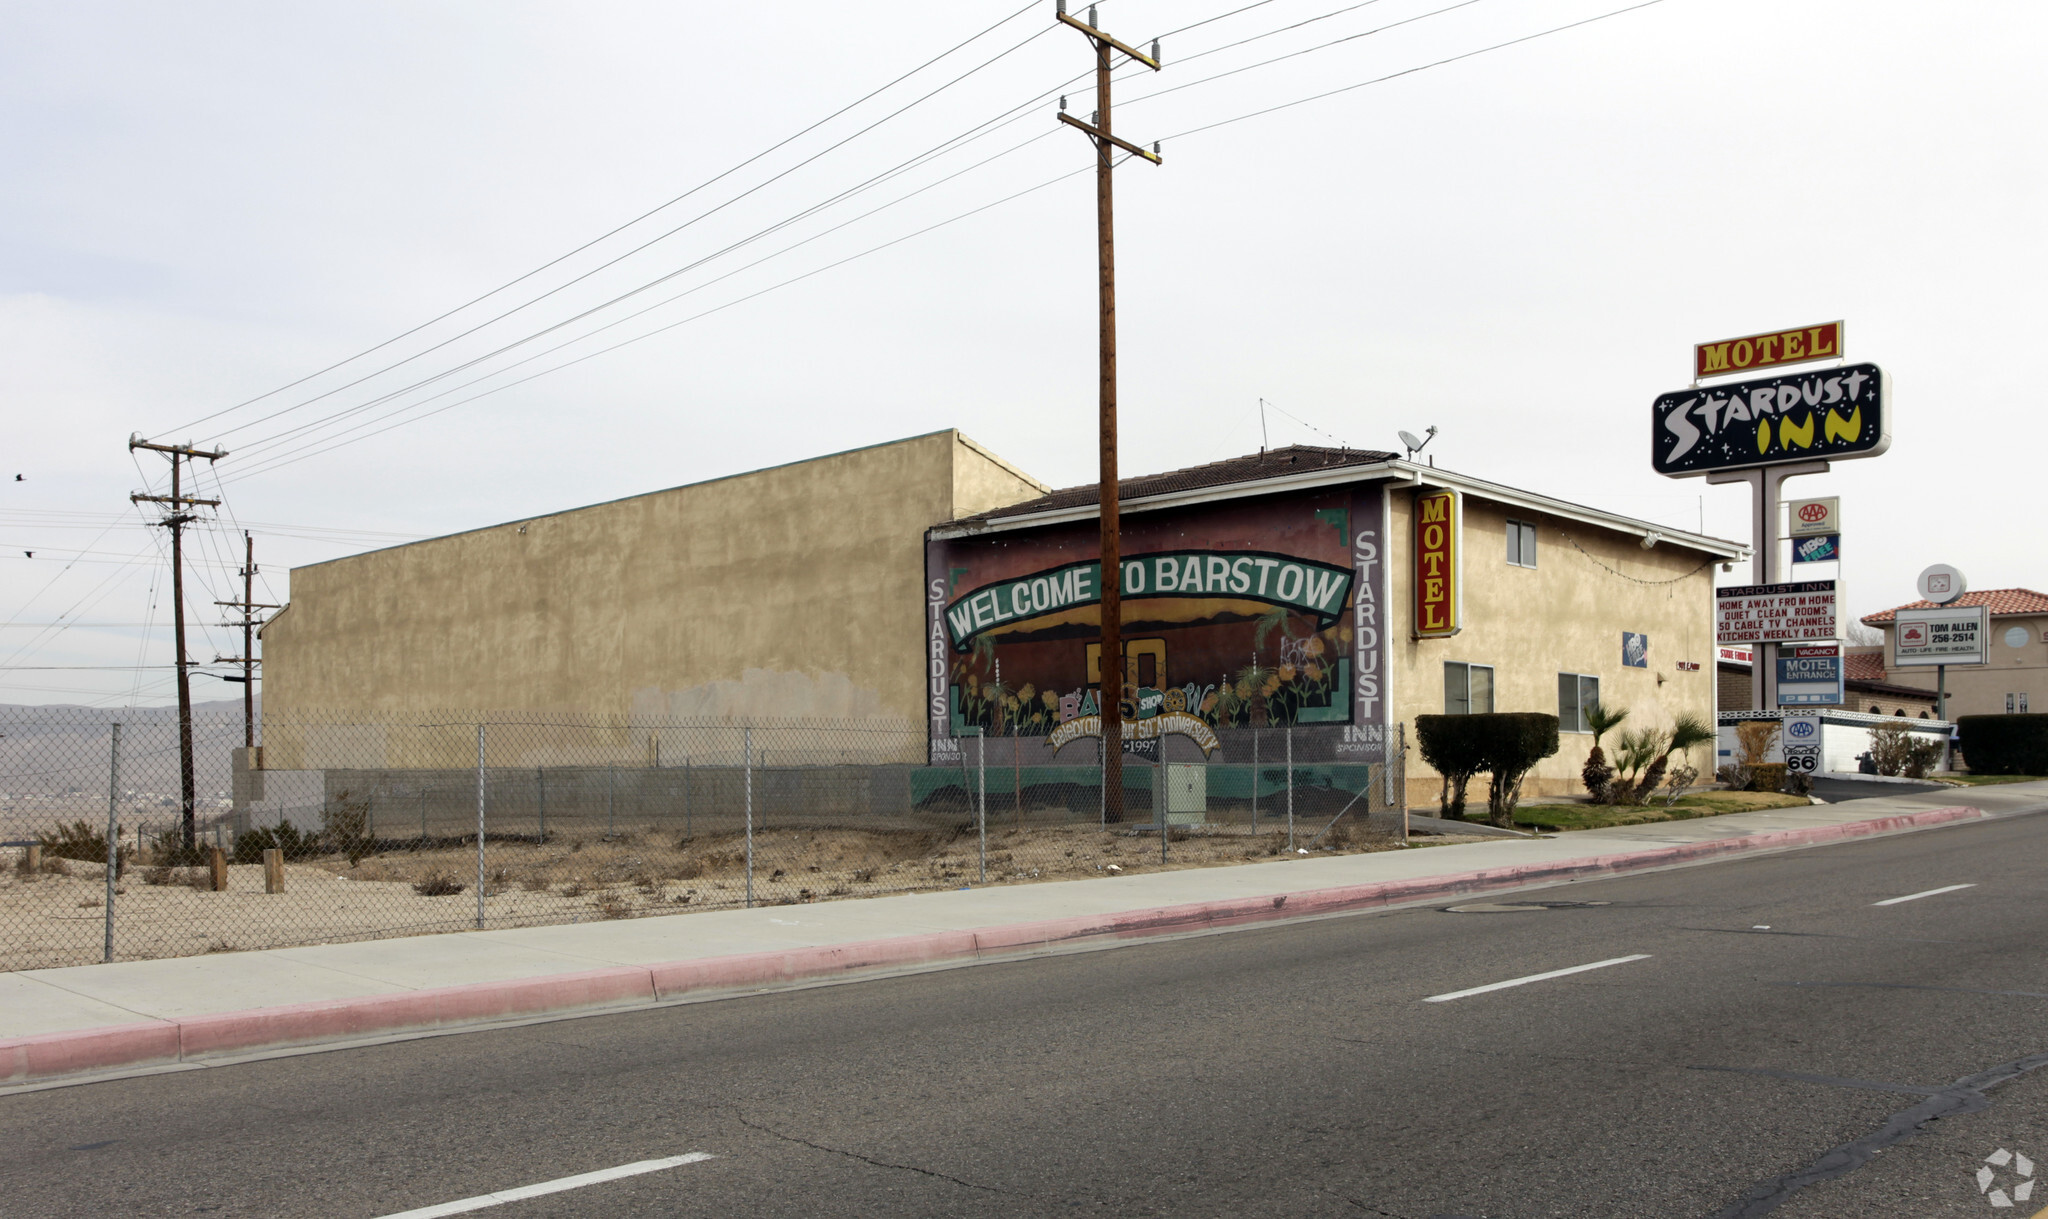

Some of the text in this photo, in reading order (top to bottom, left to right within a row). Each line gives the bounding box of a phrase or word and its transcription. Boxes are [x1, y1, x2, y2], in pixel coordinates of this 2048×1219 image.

[1703, 328, 1833, 373] MOTEL
[1664, 369, 1870, 465] STARDUST
[1756, 404, 1862, 456] INN
[1800, 504, 1827, 521] AAA
[1797, 536, 1828, 557] HBO
[1420, 497, 1447, 629] MOTEL
[948, 567, 1092, 638] WELCOME
[1155, 556, 1345, 610] BARSTOW
[1720, 582, 1831, 597] STARDUST INN
[1719, 601, 1743, 610] HOME
[1747, 599, 1775, 609] AWAY
[1808, 595, 1835, 605] HOME
[1725, 606, 1828, 620] QUIET CLEAN ROOMS
[1355, 530, 1380, 719] STARDUST
[1719, 616, 1835, 631] 50 CABLE TV CHANNELS
[1930, 624, 1949, 633] TOM
[1951, 622, 1978, 632] ALLEN
[1717, 627, 1835, 642] KITCHENS WEEKLY RATES
[929, 579, 947, 735] STARDUST
[1786, 659, 1836, 671] MOTEL
[1786, 670, 1836, 680] ENTRANCE
[1140, 694, 1164, 710] SHOP
[1786, 694, 1831, 702] POOL
[1343, 725, 1384, 743] INN
[1791, 722, 1813, 737] AAA
[1787, 755, 1816, 770] 66
